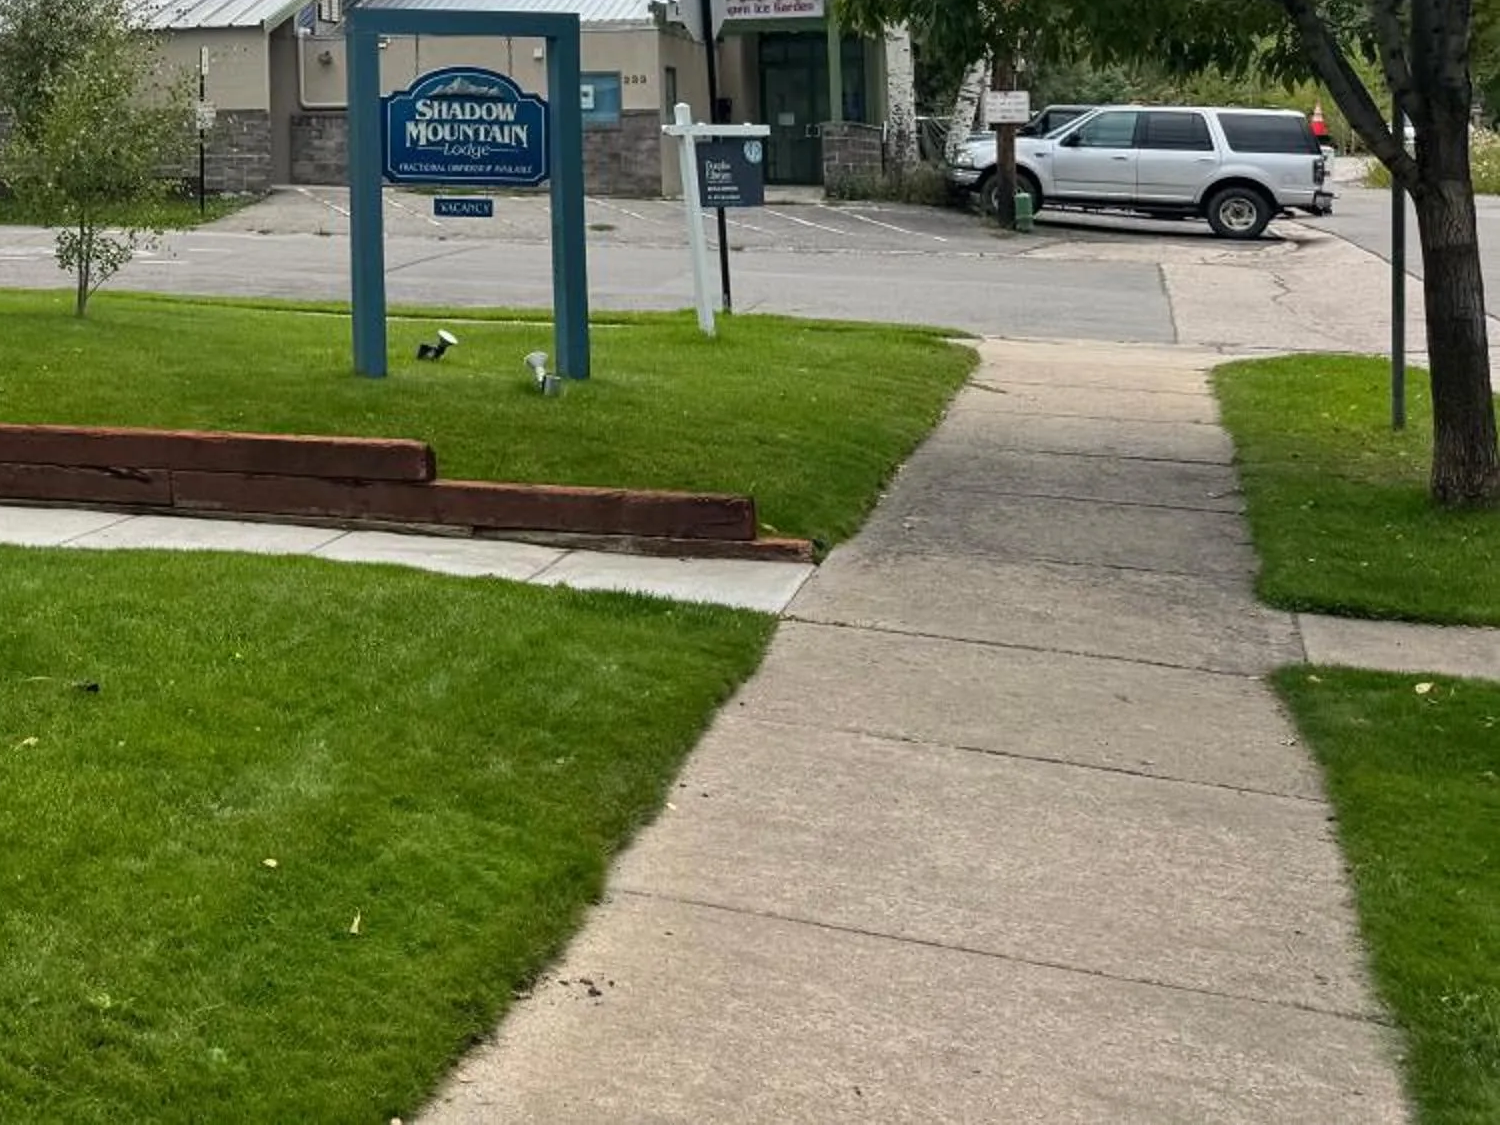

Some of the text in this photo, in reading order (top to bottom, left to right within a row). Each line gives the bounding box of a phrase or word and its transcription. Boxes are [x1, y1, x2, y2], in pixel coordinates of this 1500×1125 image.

[415, 99, 517, 121] SHADOW
[405, 120, 529, 148] MOUNTAIN
[443, 142, 491, 159] Lodge
[439, 202, 490, 214] VACANCY
